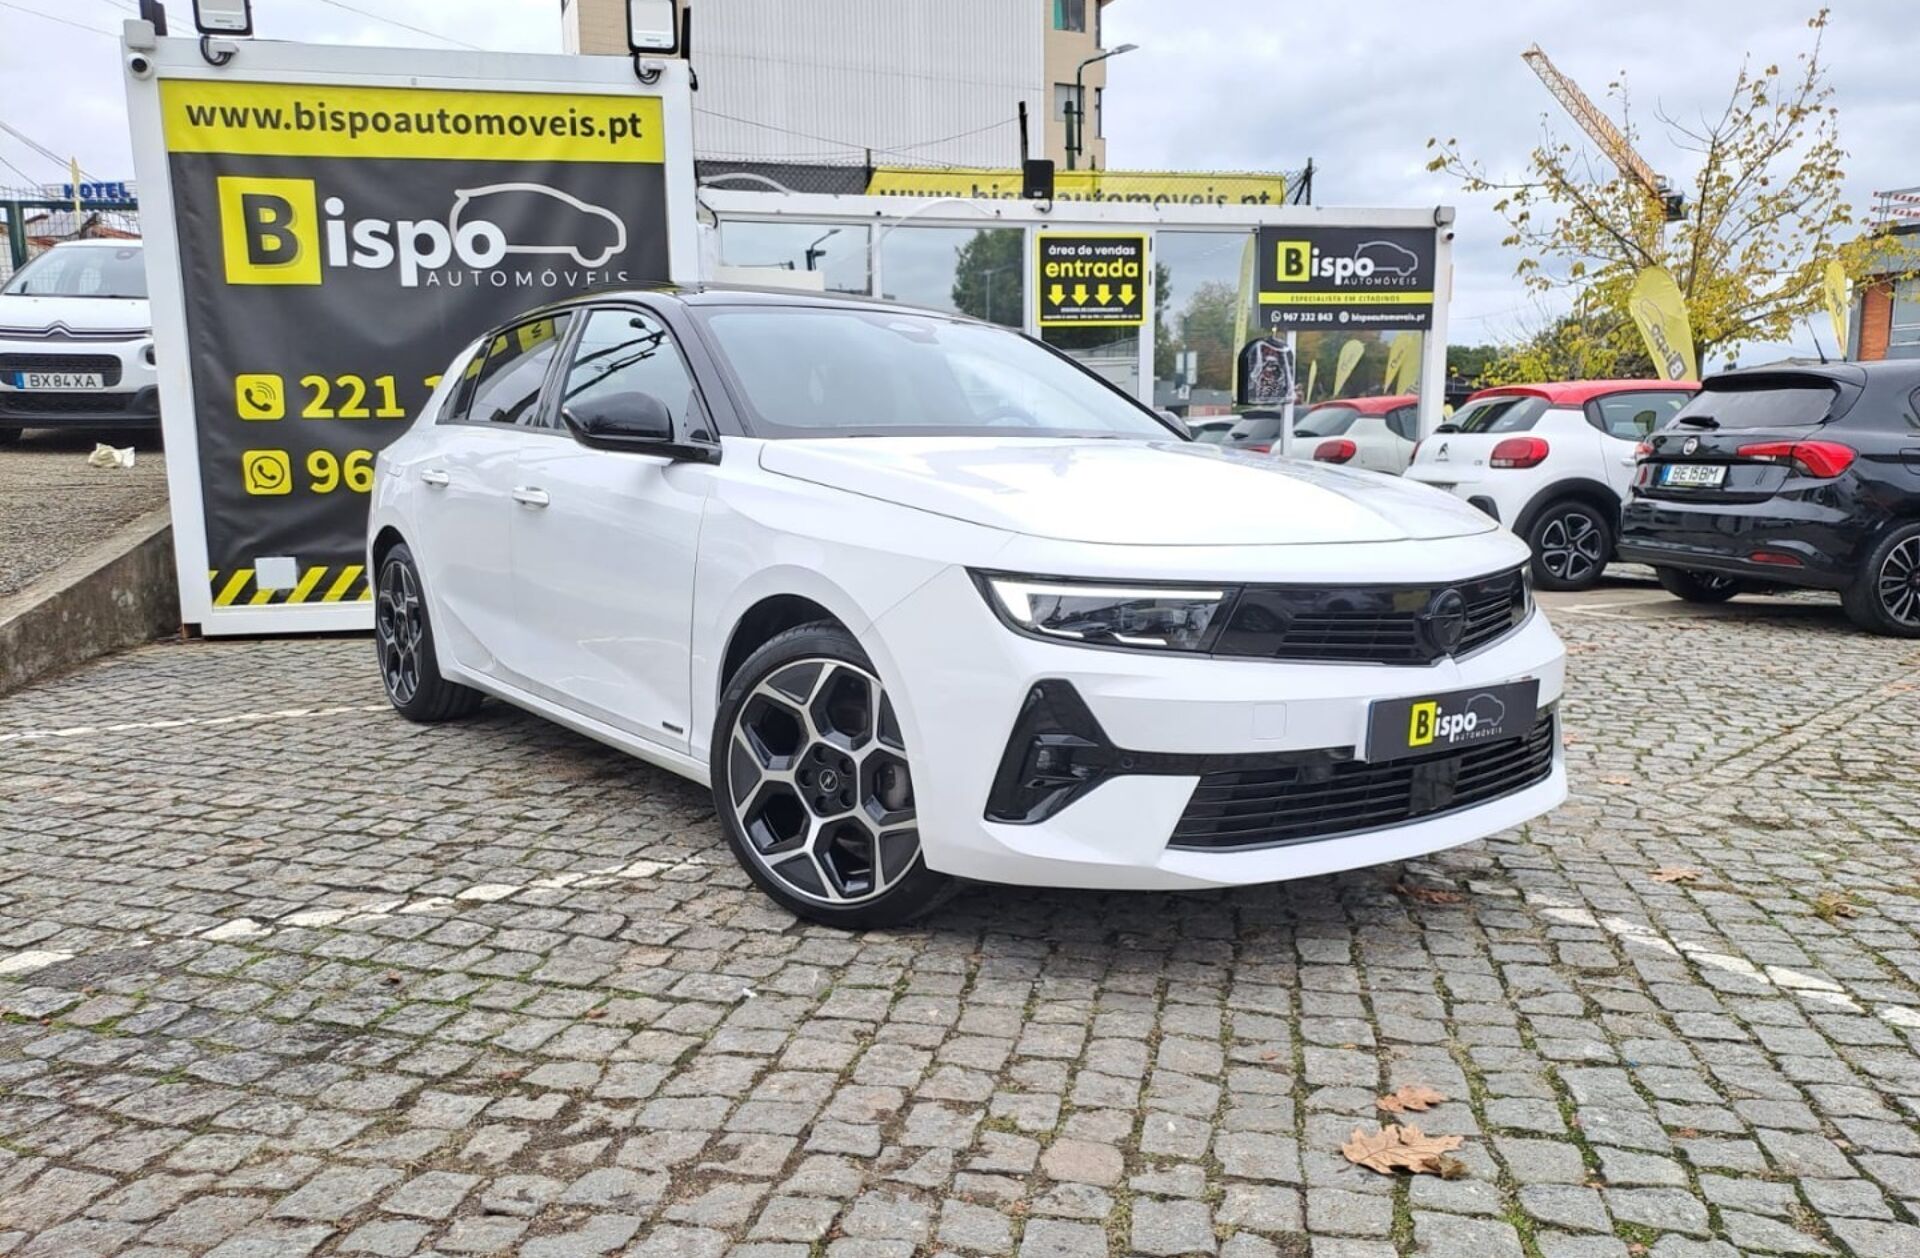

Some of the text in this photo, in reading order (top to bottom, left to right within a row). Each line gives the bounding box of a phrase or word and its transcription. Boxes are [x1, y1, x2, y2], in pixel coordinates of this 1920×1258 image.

[186, 102, 642, 144] www.bispoautomoveis.pt
[239, 192, 507, 287] Bispo
[1048, 244, 1136, 255] área de vendas
[1045, 258, 1139, 277] entrada
[1283, 247, 1376, 286] Bispo
[1343, 276, 1418, 286] AUTOMÓVEIS
[300, 374, 406, 418] 221
[1415, 706, 1477, 742] Bispo
